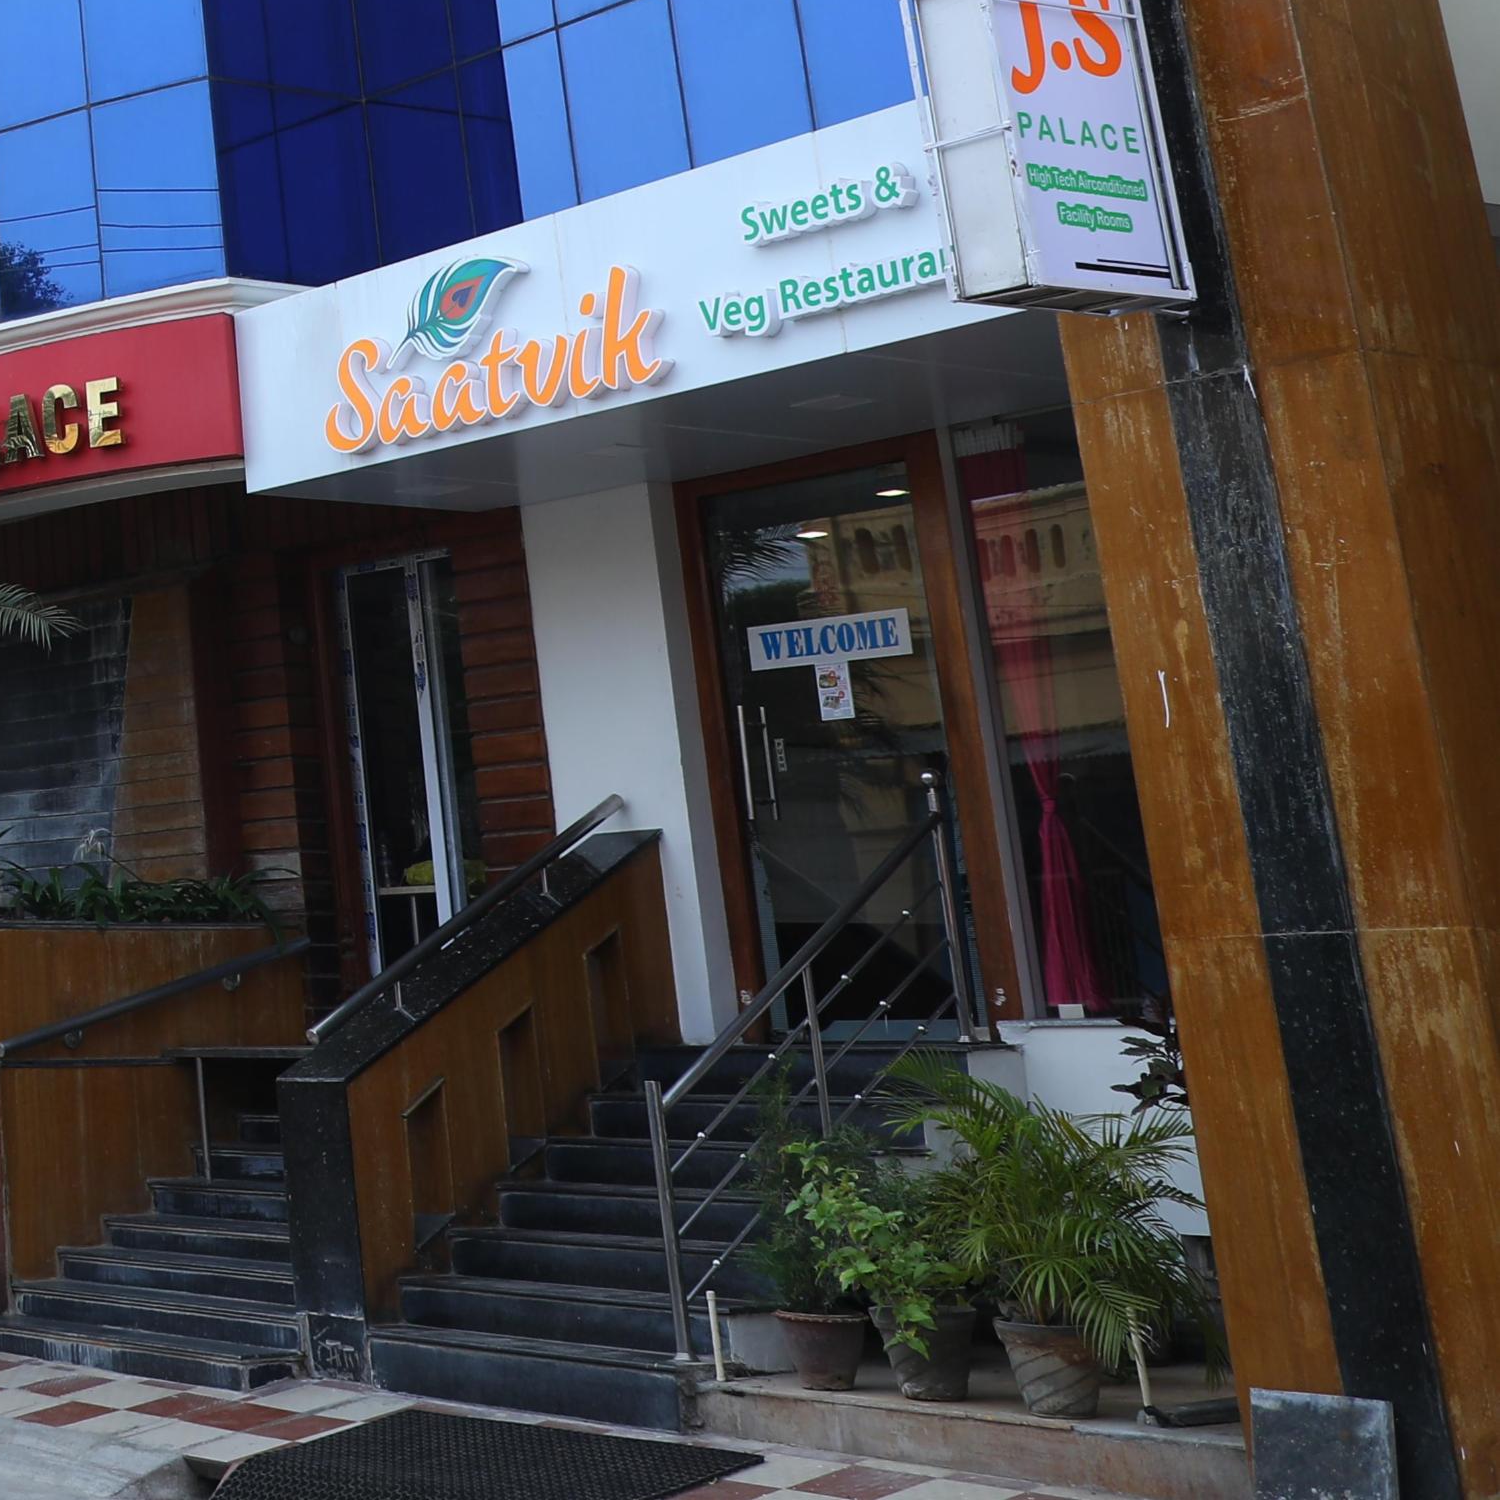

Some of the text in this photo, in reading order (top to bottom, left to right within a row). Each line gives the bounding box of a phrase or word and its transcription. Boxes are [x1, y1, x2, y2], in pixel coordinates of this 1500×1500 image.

[1017, 111, 1140, 154] PALACE
[741, 165, 901, 241] Sweets &
[1028, 167, 1146, 198] High Tech Airconditioned
[1059, 205, 1131, 229] Facility Rooms
[698, 293, 767, 332] Veg
[324, 264, 662, 455] Saatvik
[758, 617, 900, 661] WELCOME
